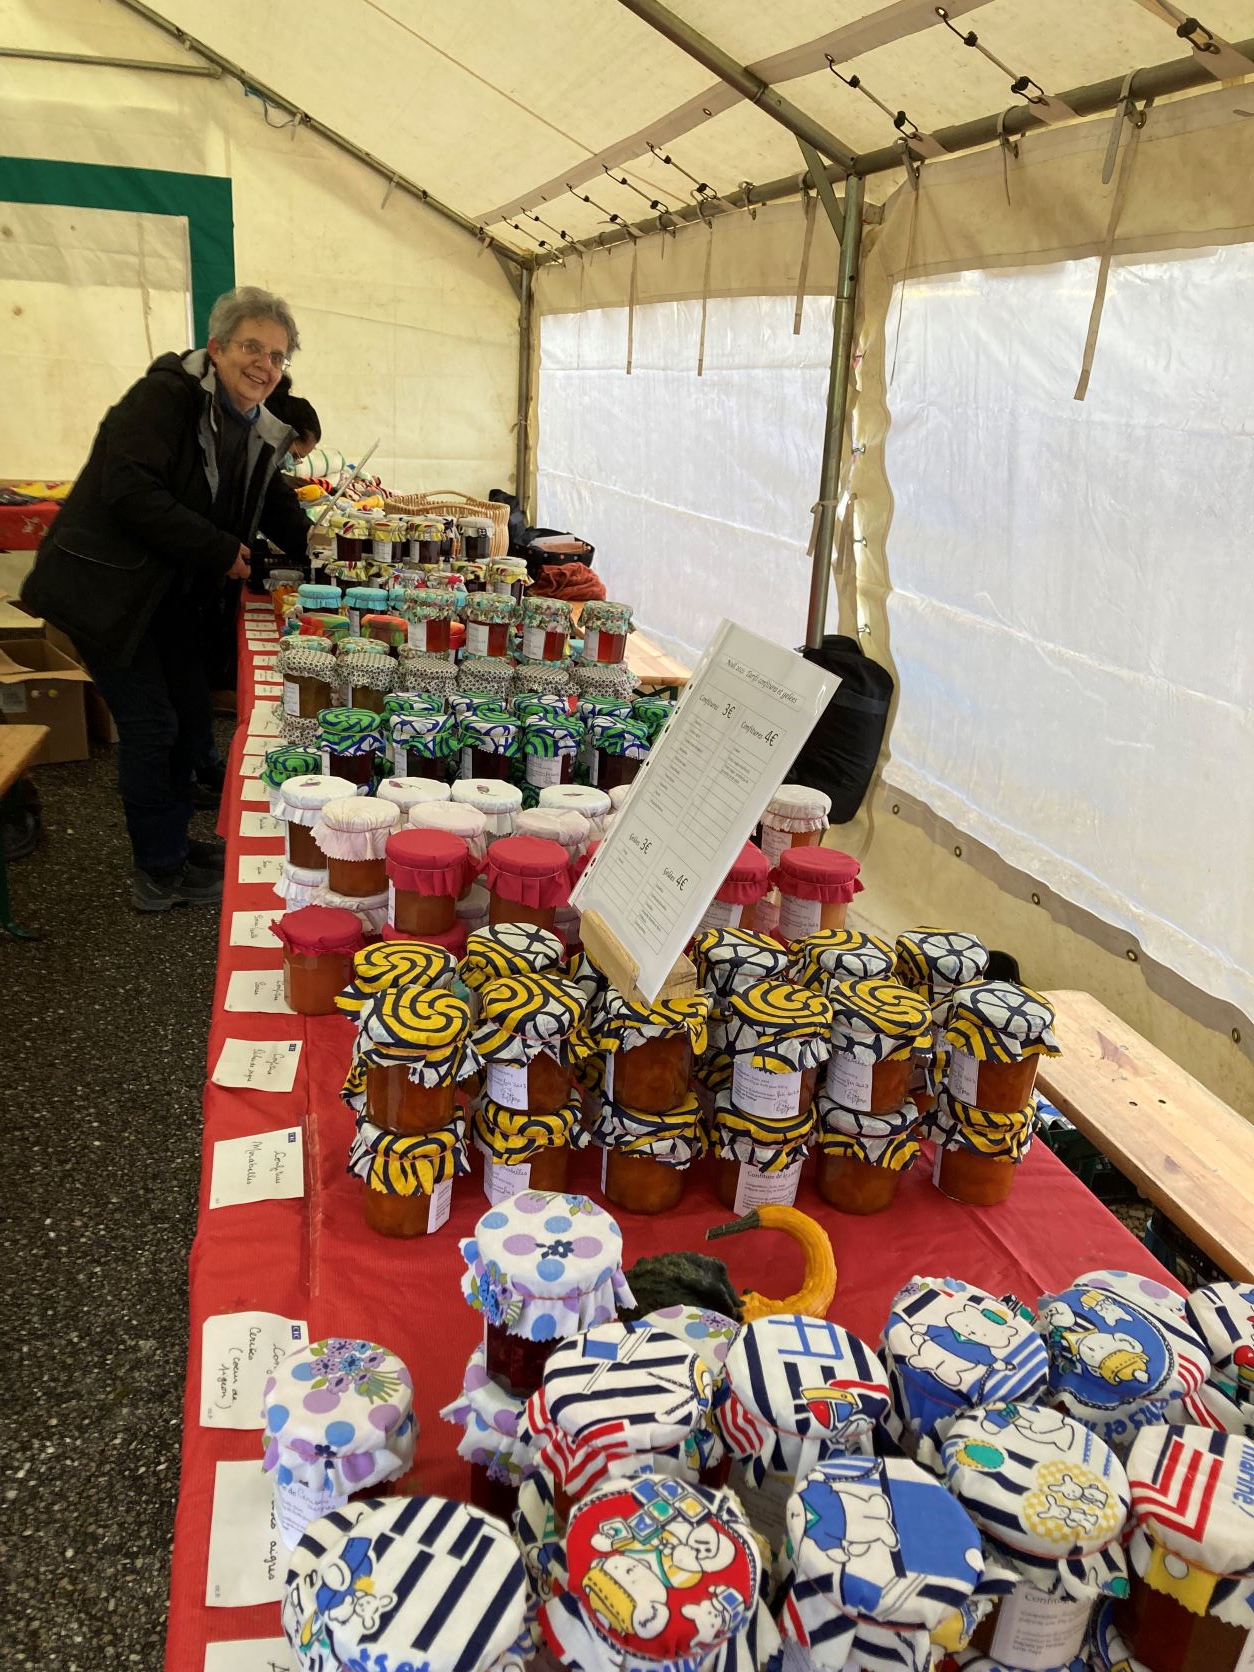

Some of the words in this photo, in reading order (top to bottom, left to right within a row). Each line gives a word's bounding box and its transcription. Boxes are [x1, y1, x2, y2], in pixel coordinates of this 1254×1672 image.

[757, 677, 777, 693] confitures
[780, 691, 797, 705] gelées
[722, 703, 736, 719] 3€
[741, 721, 763, 739] Confitures
[764, 730, 778, 747] 4€
[640, 839, 652, 854] 3€
[676, 874, 688, 891] 4€
[291, 1325, 301, 1340] CIC
